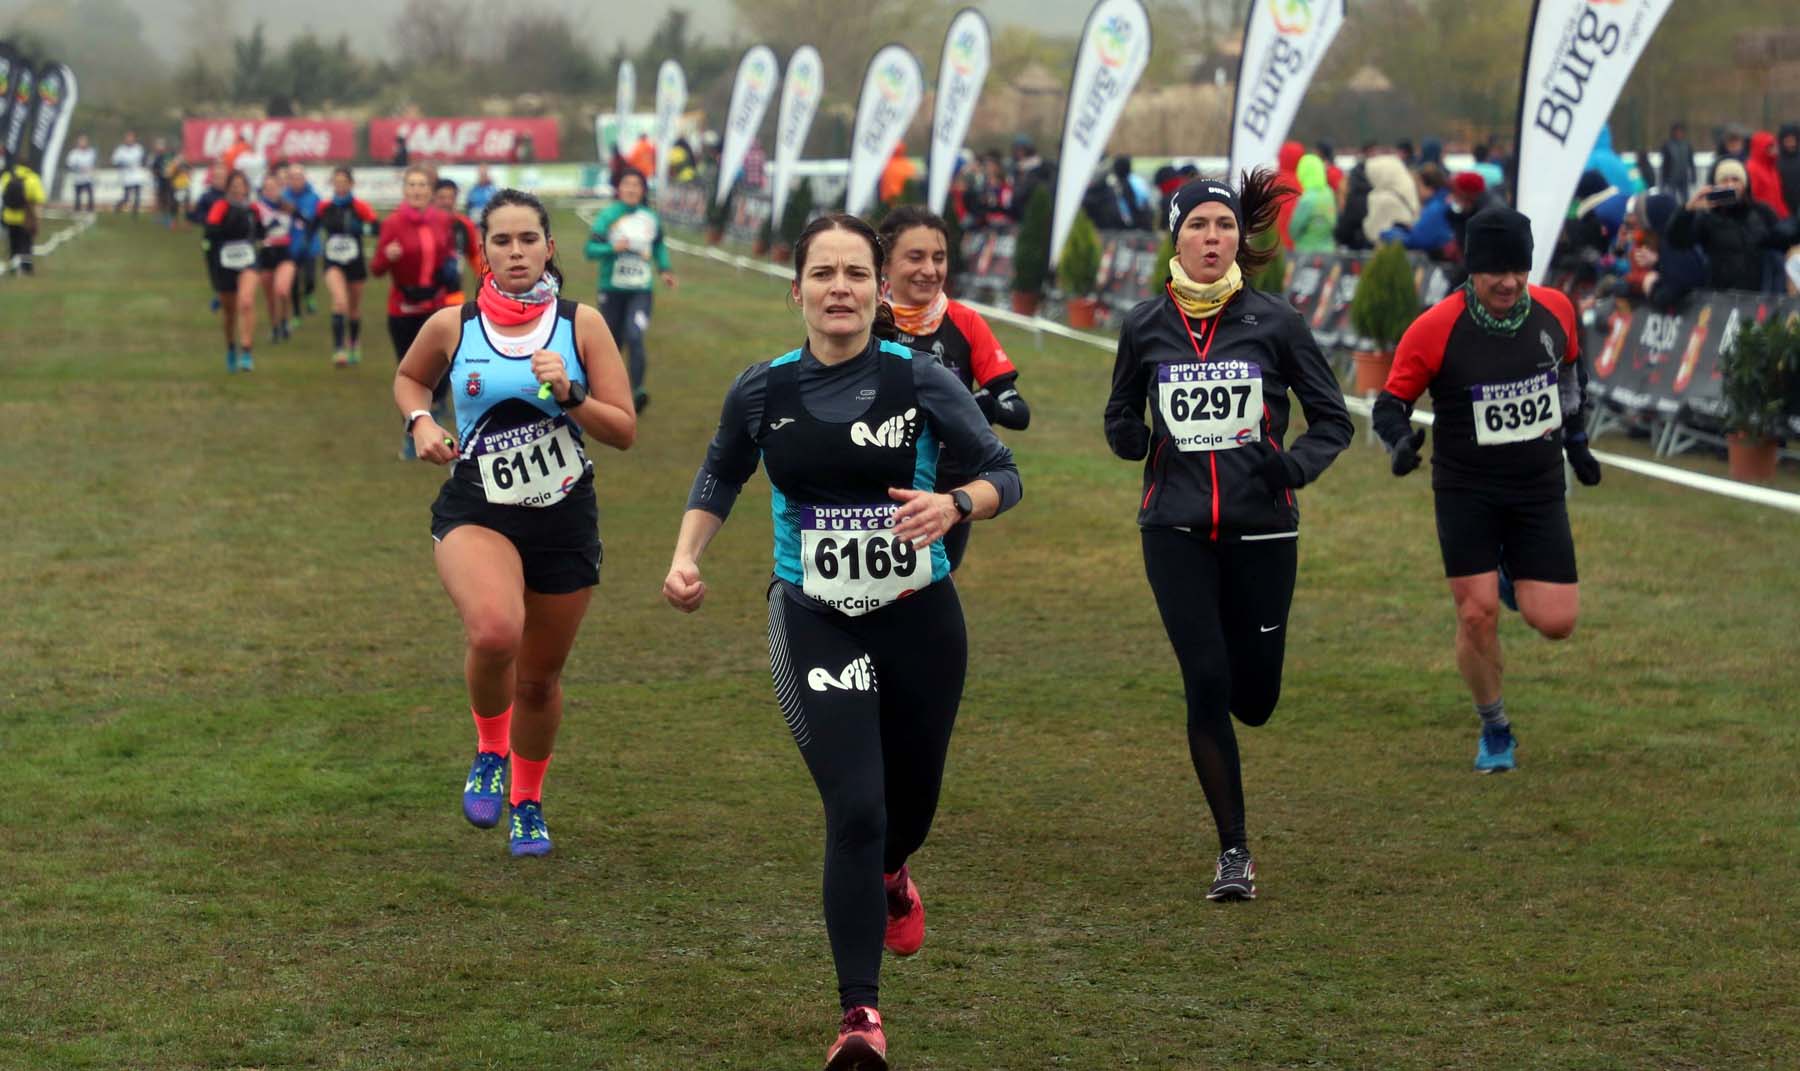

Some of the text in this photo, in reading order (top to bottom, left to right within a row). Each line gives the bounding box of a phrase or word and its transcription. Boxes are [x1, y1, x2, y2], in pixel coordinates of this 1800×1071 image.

[1169, 360, 1249, 373] DIPUTACIÓN
[1169, 369, 1250, 382] BURGOS
[1170, 384, 1252, 422] 6297
[1485, 393, 1553, 432] 6392
[1172, 433, 1223, 446] berCaja
[491, 435, 567, 490] 6111
[815, 504, 903, 519] DIPUTACIÓ
[814, 536, 917, 580] 6169
